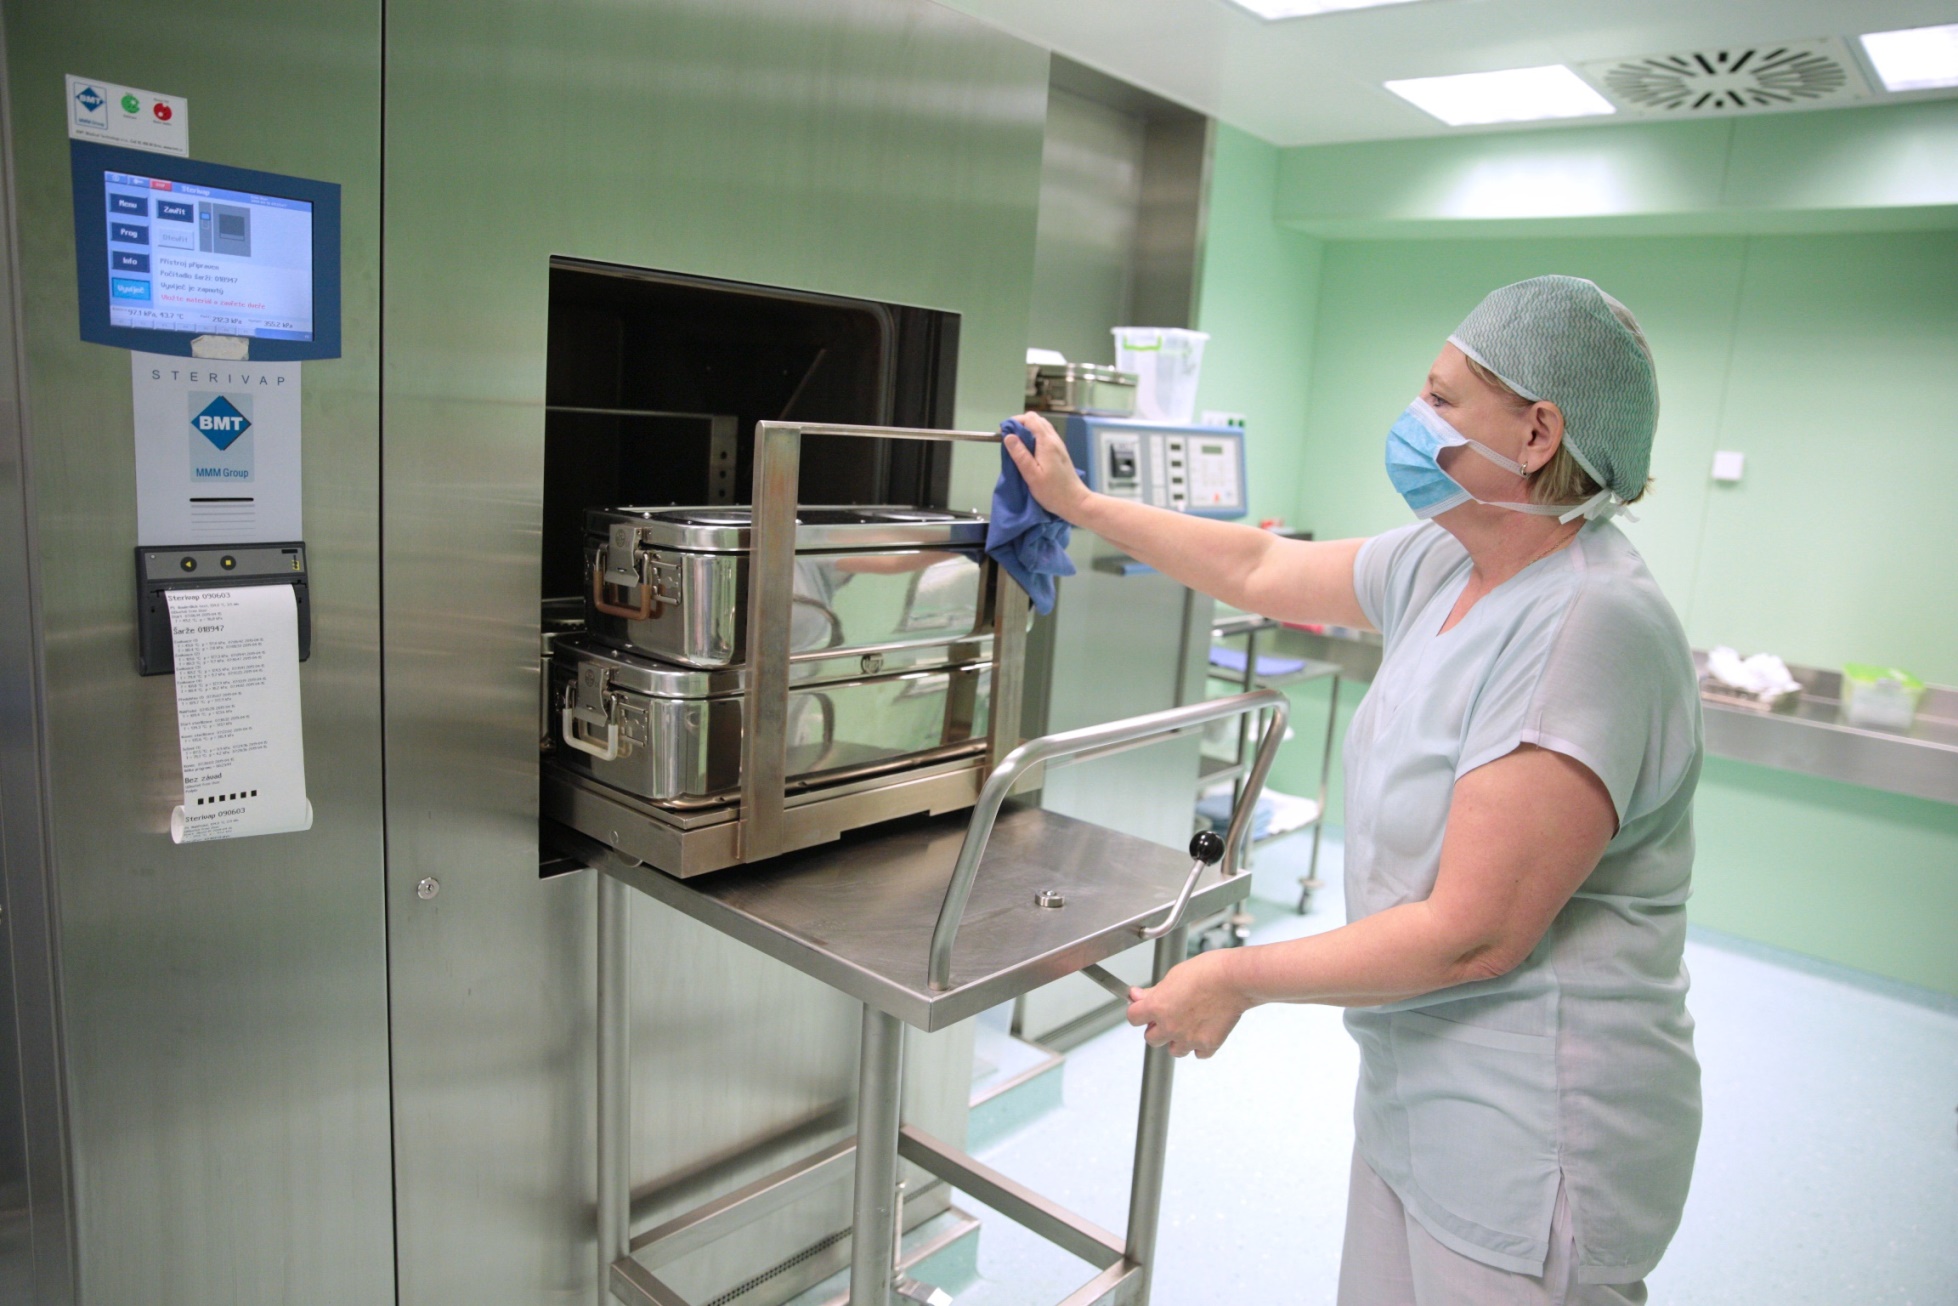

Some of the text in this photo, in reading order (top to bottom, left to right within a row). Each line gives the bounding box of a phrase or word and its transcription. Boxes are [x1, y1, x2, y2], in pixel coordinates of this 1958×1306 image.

[118, 199, 138, 209] Menu
[120, 228, 138, 239] Prog
[122, 256, 138, 265] Info
[188, 284, 196, 292] je
[152, 369, 285, 386] STERIVAP
[199, 415, 243, 431] BMT
[196, 467, 249, 479] MMM Group
[173, 624, 225, 635] Šarže 018947
[184, 776, 199, 784] Bez
[185, 807, 246, 823] Sterivap 090603
